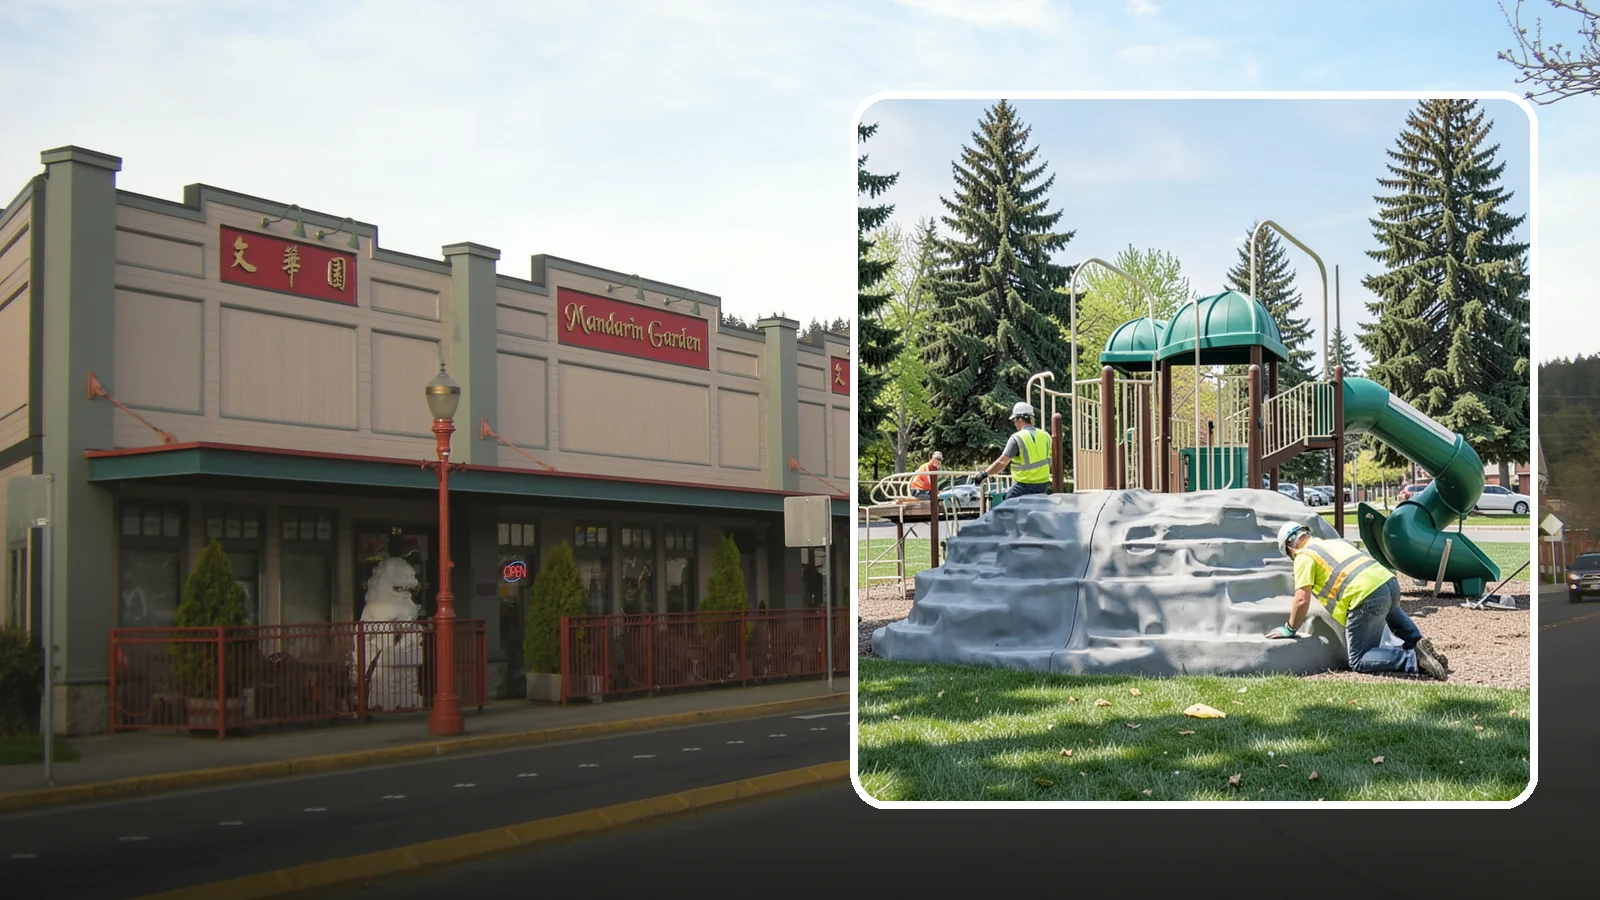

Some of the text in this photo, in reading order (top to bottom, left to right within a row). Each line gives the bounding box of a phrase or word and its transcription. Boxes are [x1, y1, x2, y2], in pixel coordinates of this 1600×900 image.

[231, 236, 346, 291] 文華園
[564, 302, 702, 352] Mandarin Garden
[503, 565, 527, 578] OPEN
